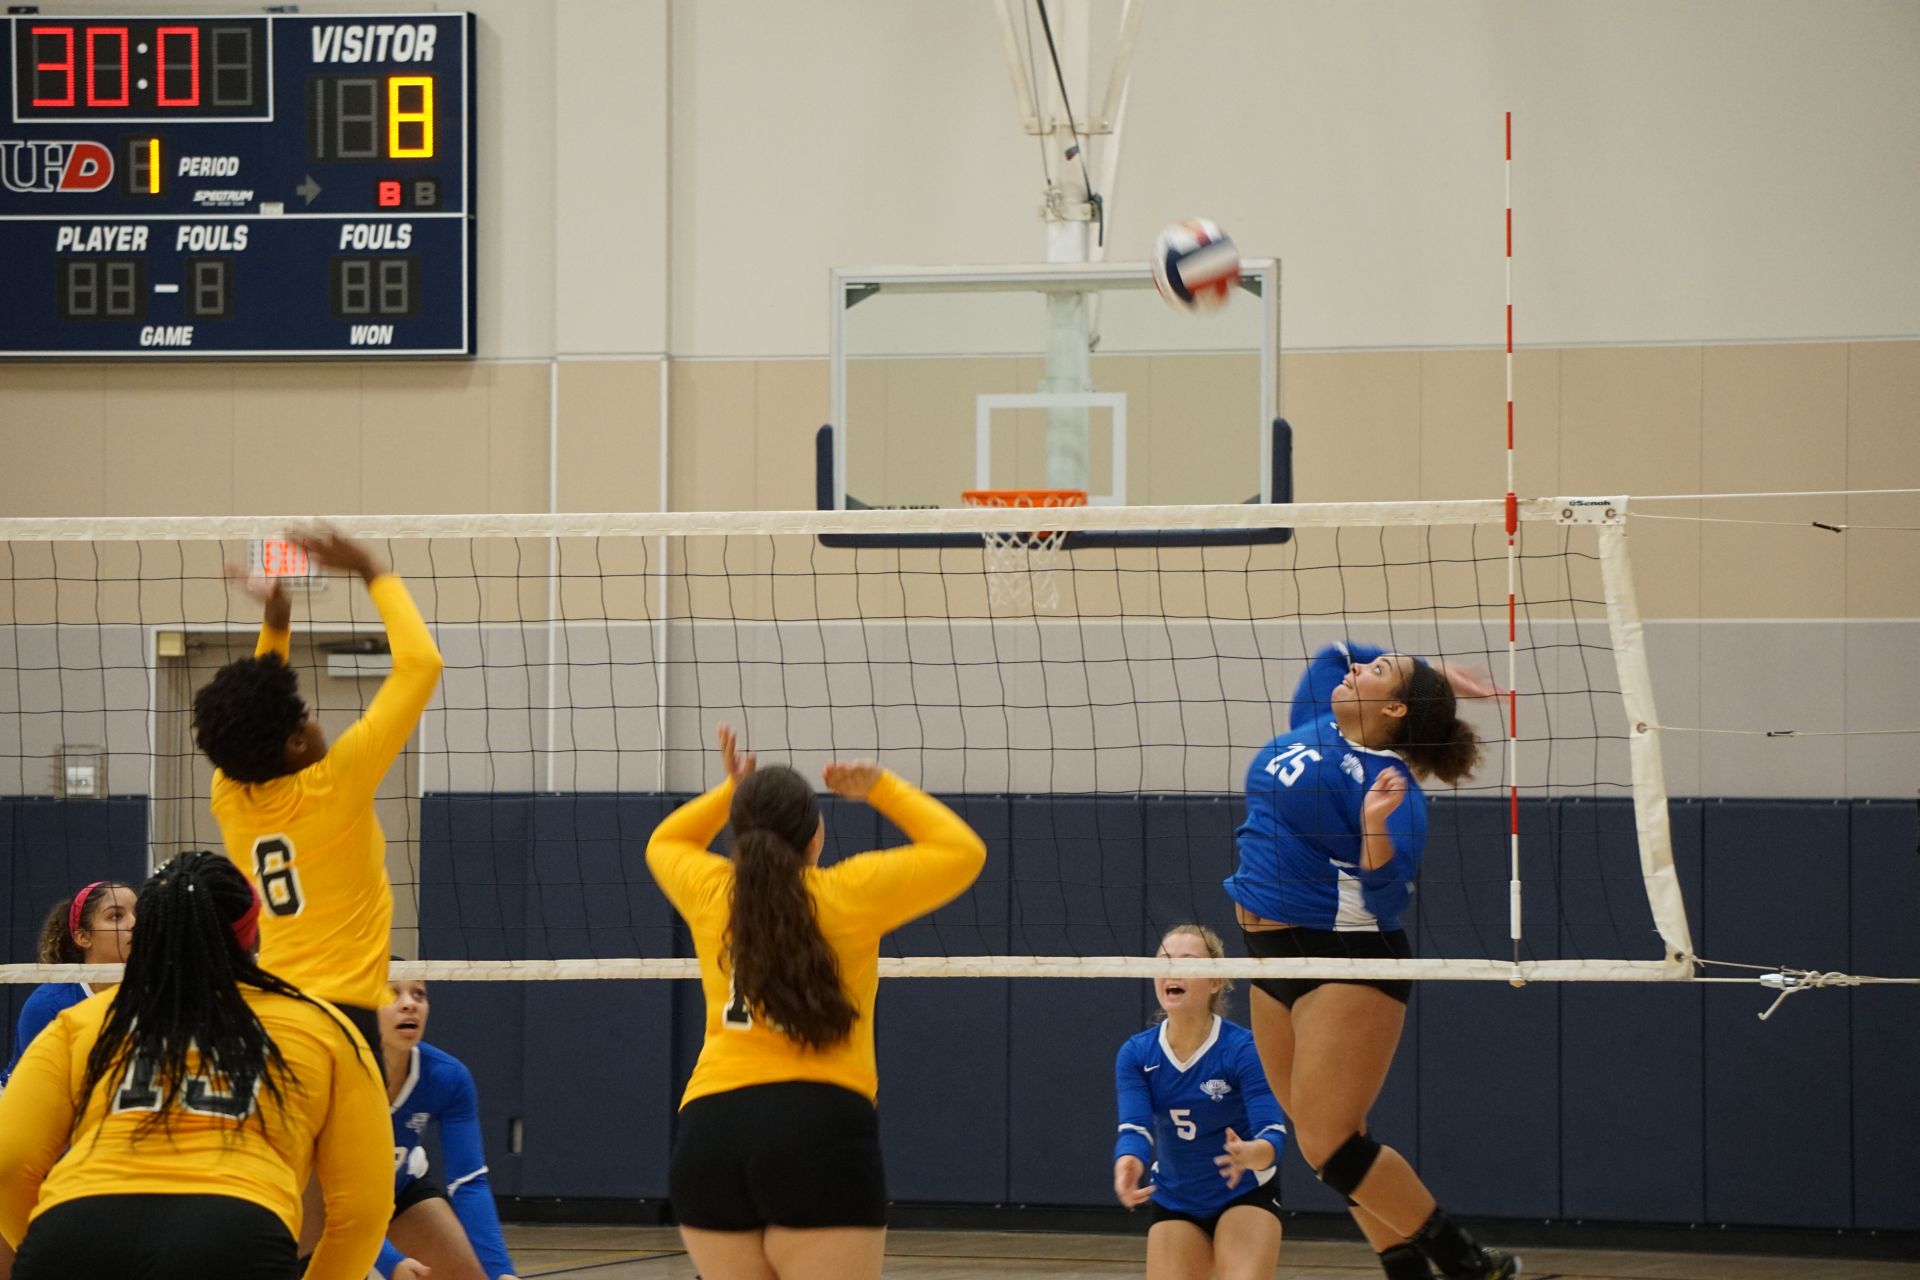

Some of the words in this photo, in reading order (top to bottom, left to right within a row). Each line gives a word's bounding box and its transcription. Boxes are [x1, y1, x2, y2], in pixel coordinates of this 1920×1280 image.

[311, 24, 438, 63] VISITOR
[388, 76, 434, 158] 8
[178, 156, 241, 177] PERIOD
[193, 189, 254, 202] SPECTRUM
[55, 225, 149, 252] PLAYER
[175, 224, 249, 252] FOULS
[339, 223, 413, 251] FOULS
[139, 325, 194, 347] GAME
[350, 324, 395, 346] WON
[252, 834, 305, 918] 6
[1169, 1108, 1197, 1141] 5
